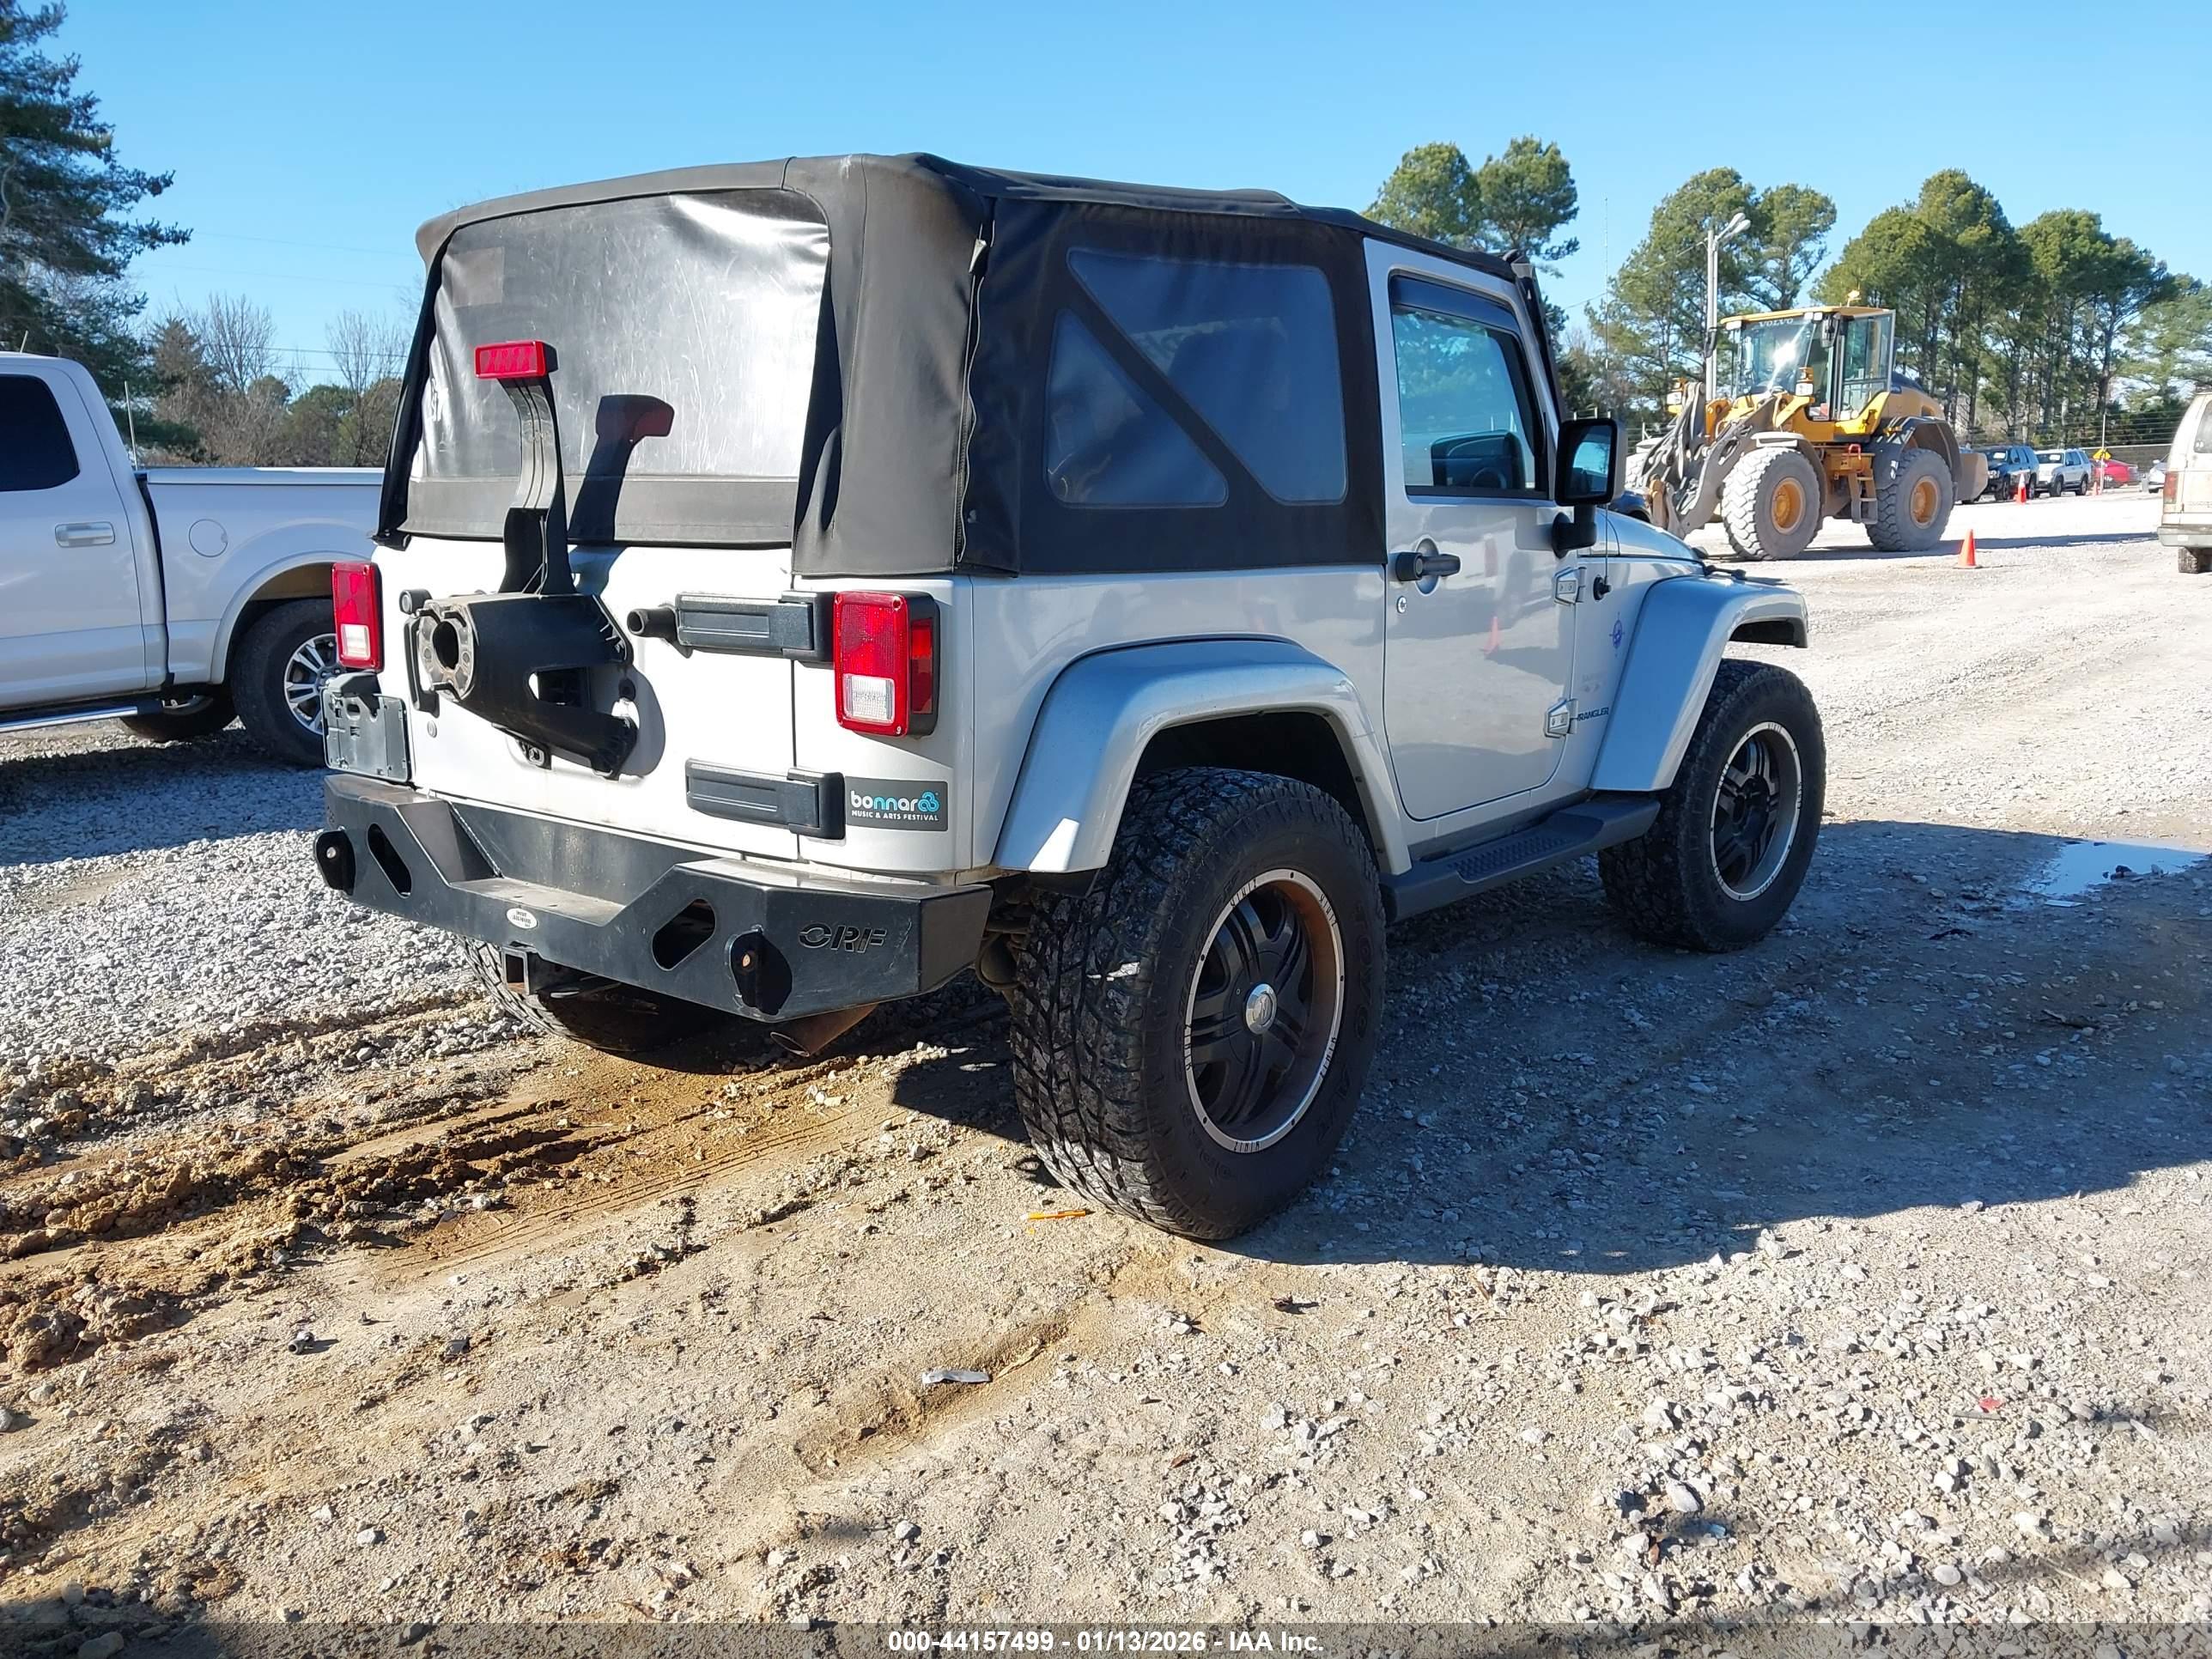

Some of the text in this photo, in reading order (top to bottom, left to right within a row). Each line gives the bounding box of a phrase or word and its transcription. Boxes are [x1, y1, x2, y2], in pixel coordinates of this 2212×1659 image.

[1759, 318, 1794, 327] VOLVO
[1577, 707, 1609, 721] RANGLER
[851, 810, 873, 818] MUSIC
[903, 813, 939, 822] FESTIVAL
